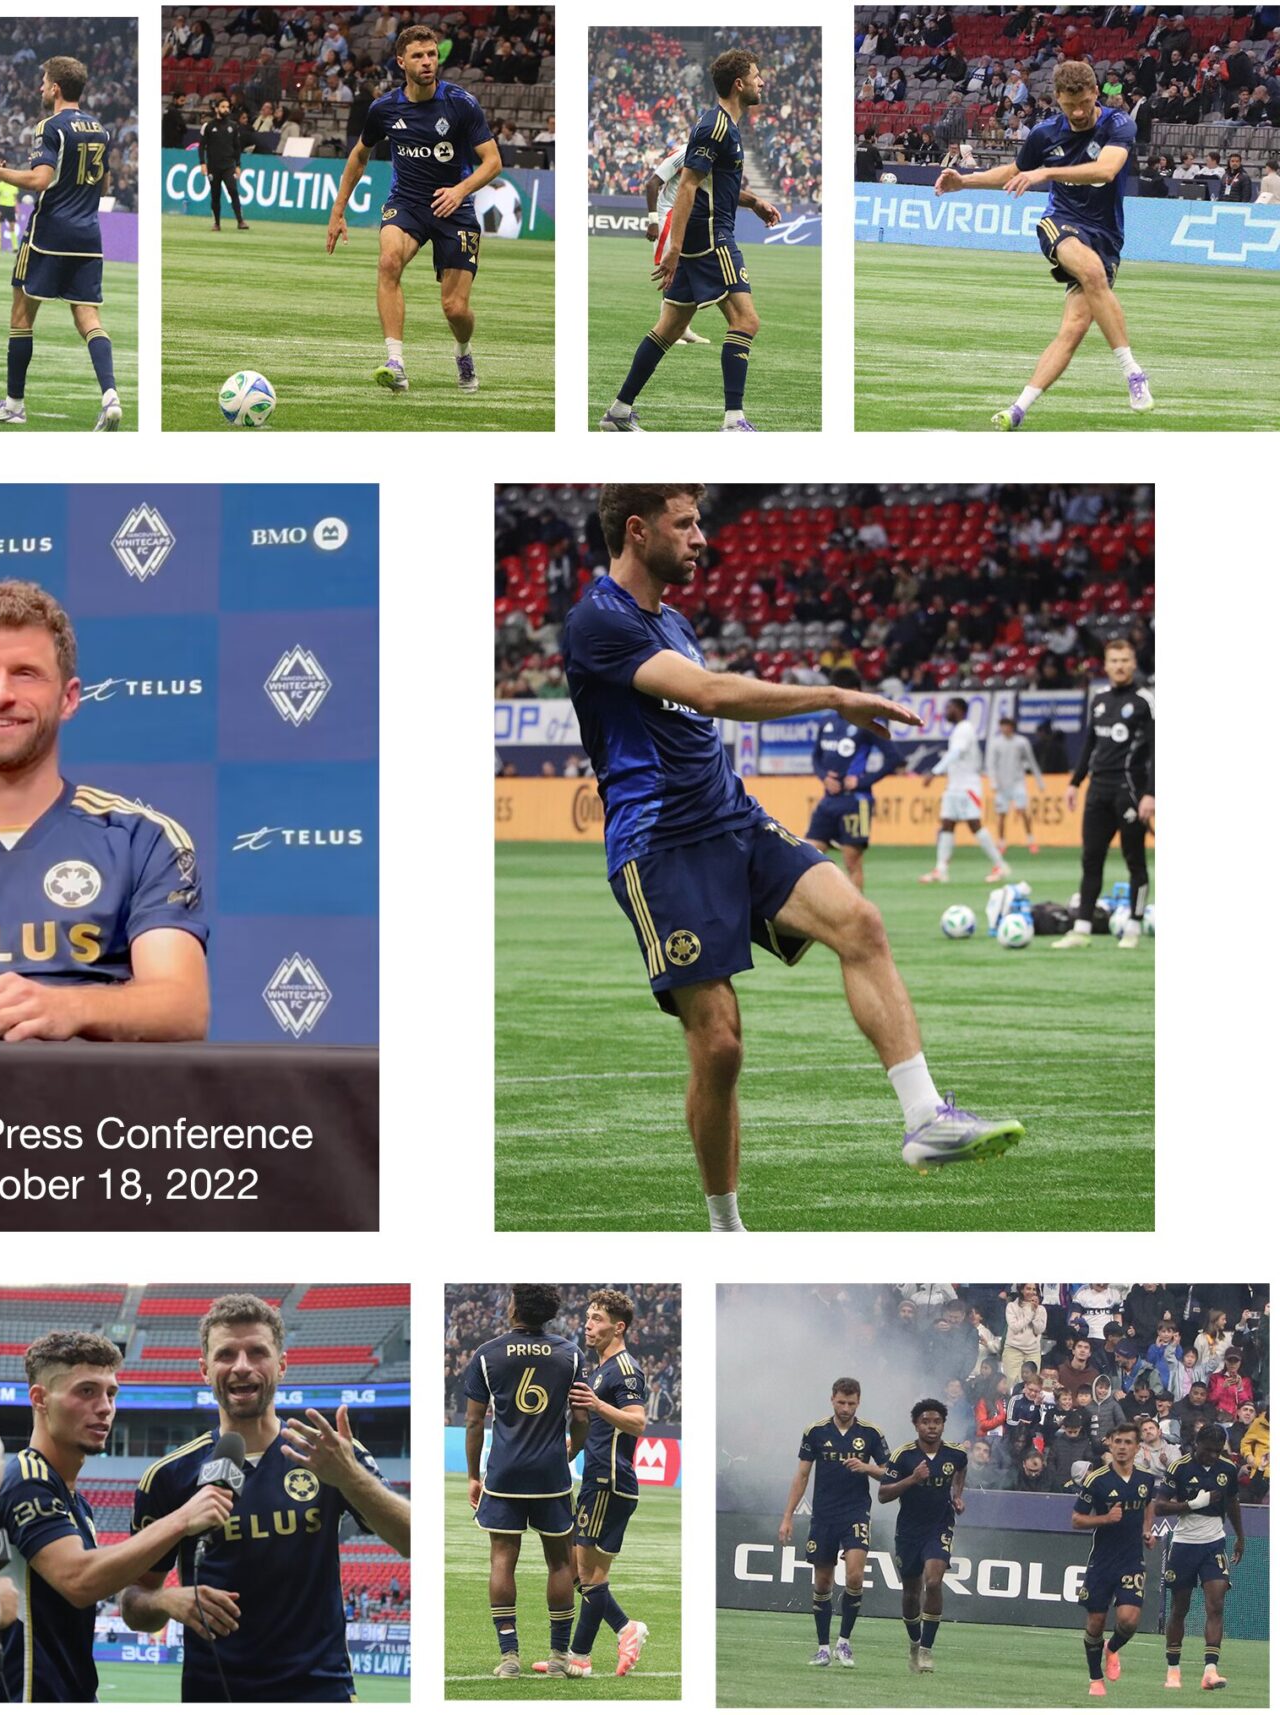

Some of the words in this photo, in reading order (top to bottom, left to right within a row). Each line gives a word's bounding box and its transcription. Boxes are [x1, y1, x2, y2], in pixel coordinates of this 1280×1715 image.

[397, 145, 431, 158] BMO
[76, 143, 105, 185] 13
[166, 163, 372, 213] COSULTING
[457, 231, 480, 255] 13
[115, 536, 171, 548] WHITECAPS
[252, 527, 307, 545] BMO
[137, 546, 149, 556] FC
[126, 679, 203, 696] TELUS
[269, 681, 326, 691] WHITECAPS
[291, 690, 303, 700] FC
[282, 829, 363, 846] TELUS
[268, 990, 326, 1001] WHITECAPS
[291, 1000, 303, 1010] FC
[507, 1344, 552, 1357] PRISO
[197, 1391, 219, 1405] BL
[341, 1389, 376, 1403] BLG
[515, 1367, 549, 1415] 6
[822, 1451, 865, 1462] TELUS
[886, 1468, 899, 1478] LG
[225, 1507, 320, 1541] ELUS
[578, 1505, 589, 1528] 6
[852, 1523, 869, 1538] 13
[1122, 1573, 1144, 1589] 20
[122, 1645, 160, 1662] BLG
[374, 1654, 402, 1674] LAW
